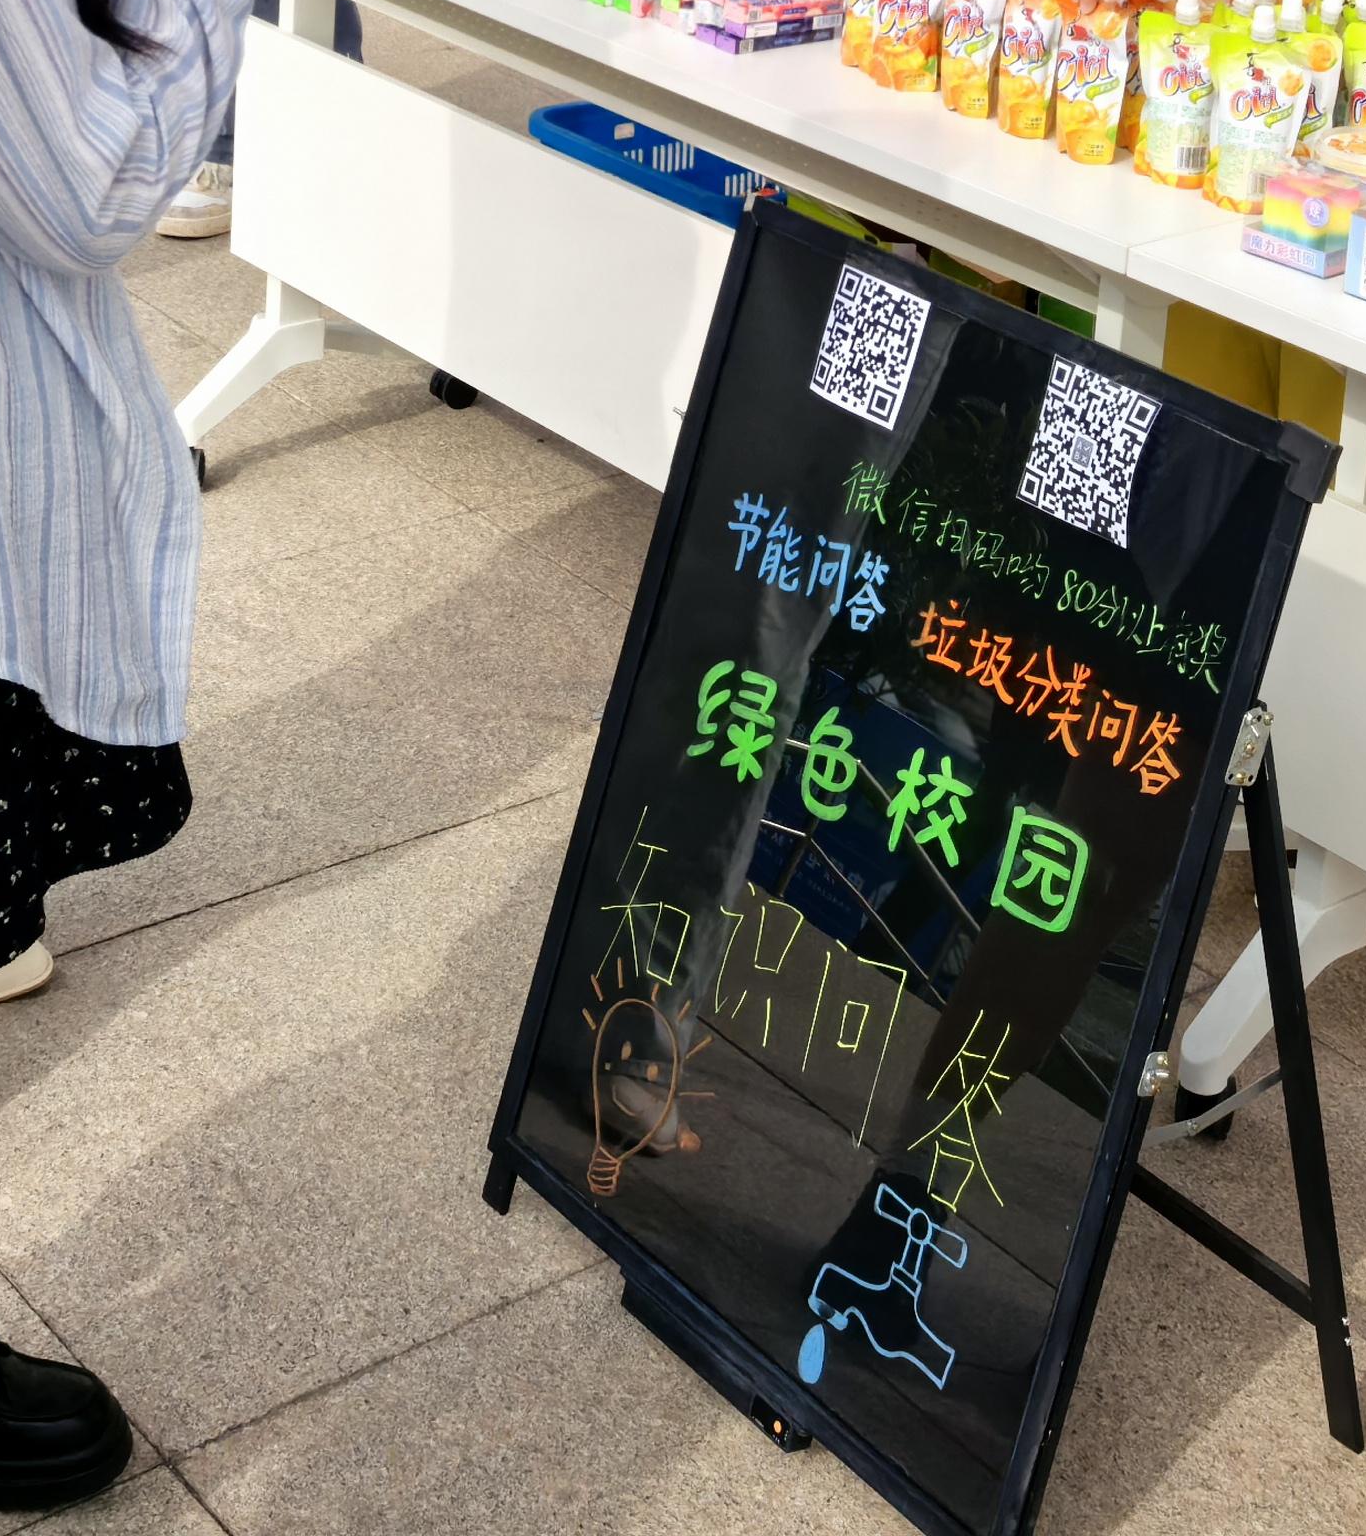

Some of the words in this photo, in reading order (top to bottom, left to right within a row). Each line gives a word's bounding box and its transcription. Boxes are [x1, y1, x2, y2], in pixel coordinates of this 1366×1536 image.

[727, 491, 890, 632] 节能问答
[911, 599, 1184, 796] 垃圾分类问答
[685, 659, 1089, 934] 绿色校园
